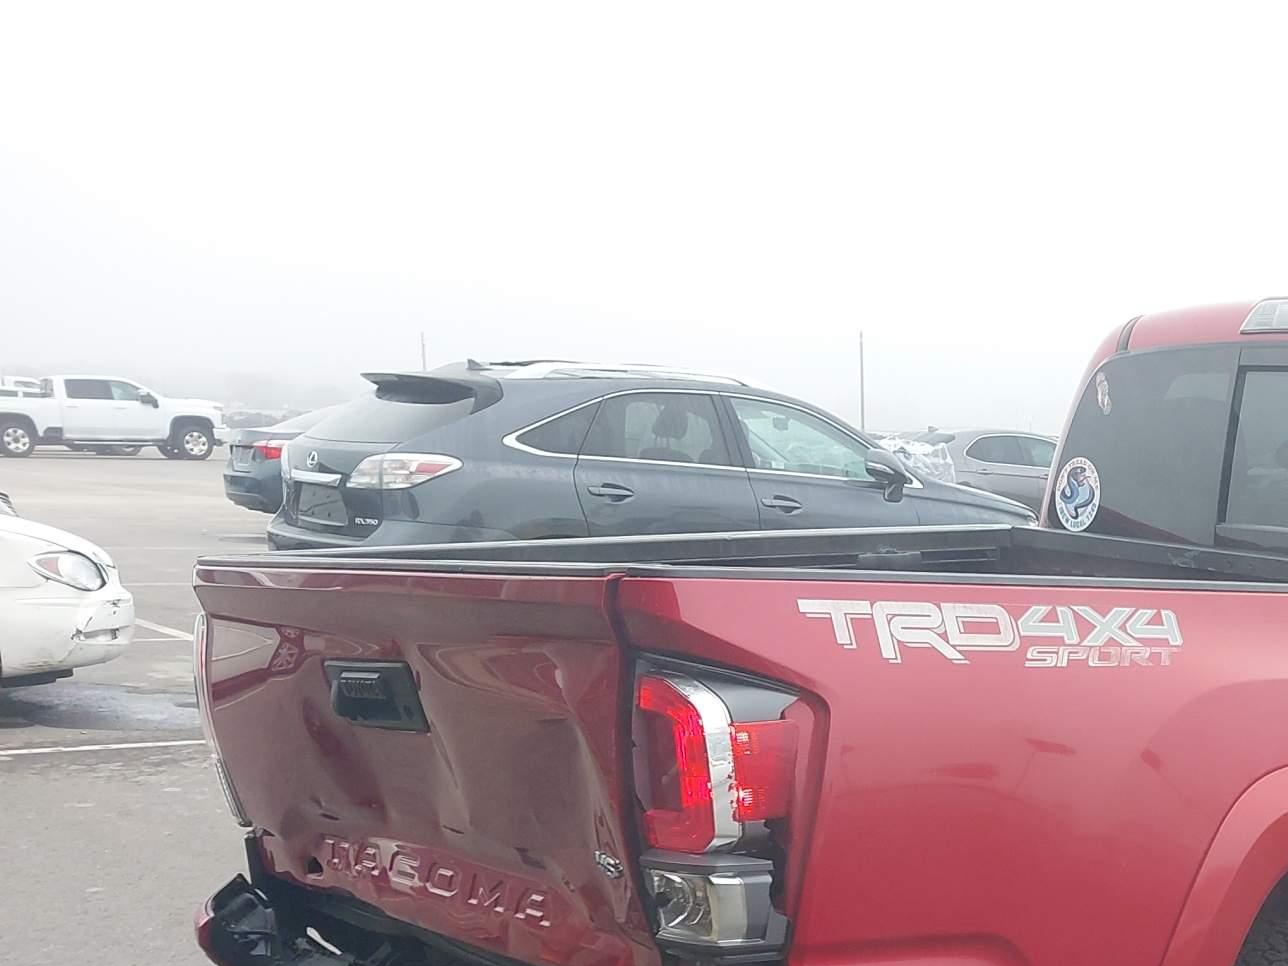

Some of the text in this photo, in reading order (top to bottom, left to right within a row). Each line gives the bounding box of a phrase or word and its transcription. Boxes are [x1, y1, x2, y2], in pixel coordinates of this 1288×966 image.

[797, 599, 1020, 664] TRD
[1025, 645, 1180, 668] SPORT
[321, 834, 551, 928] TACOMA
